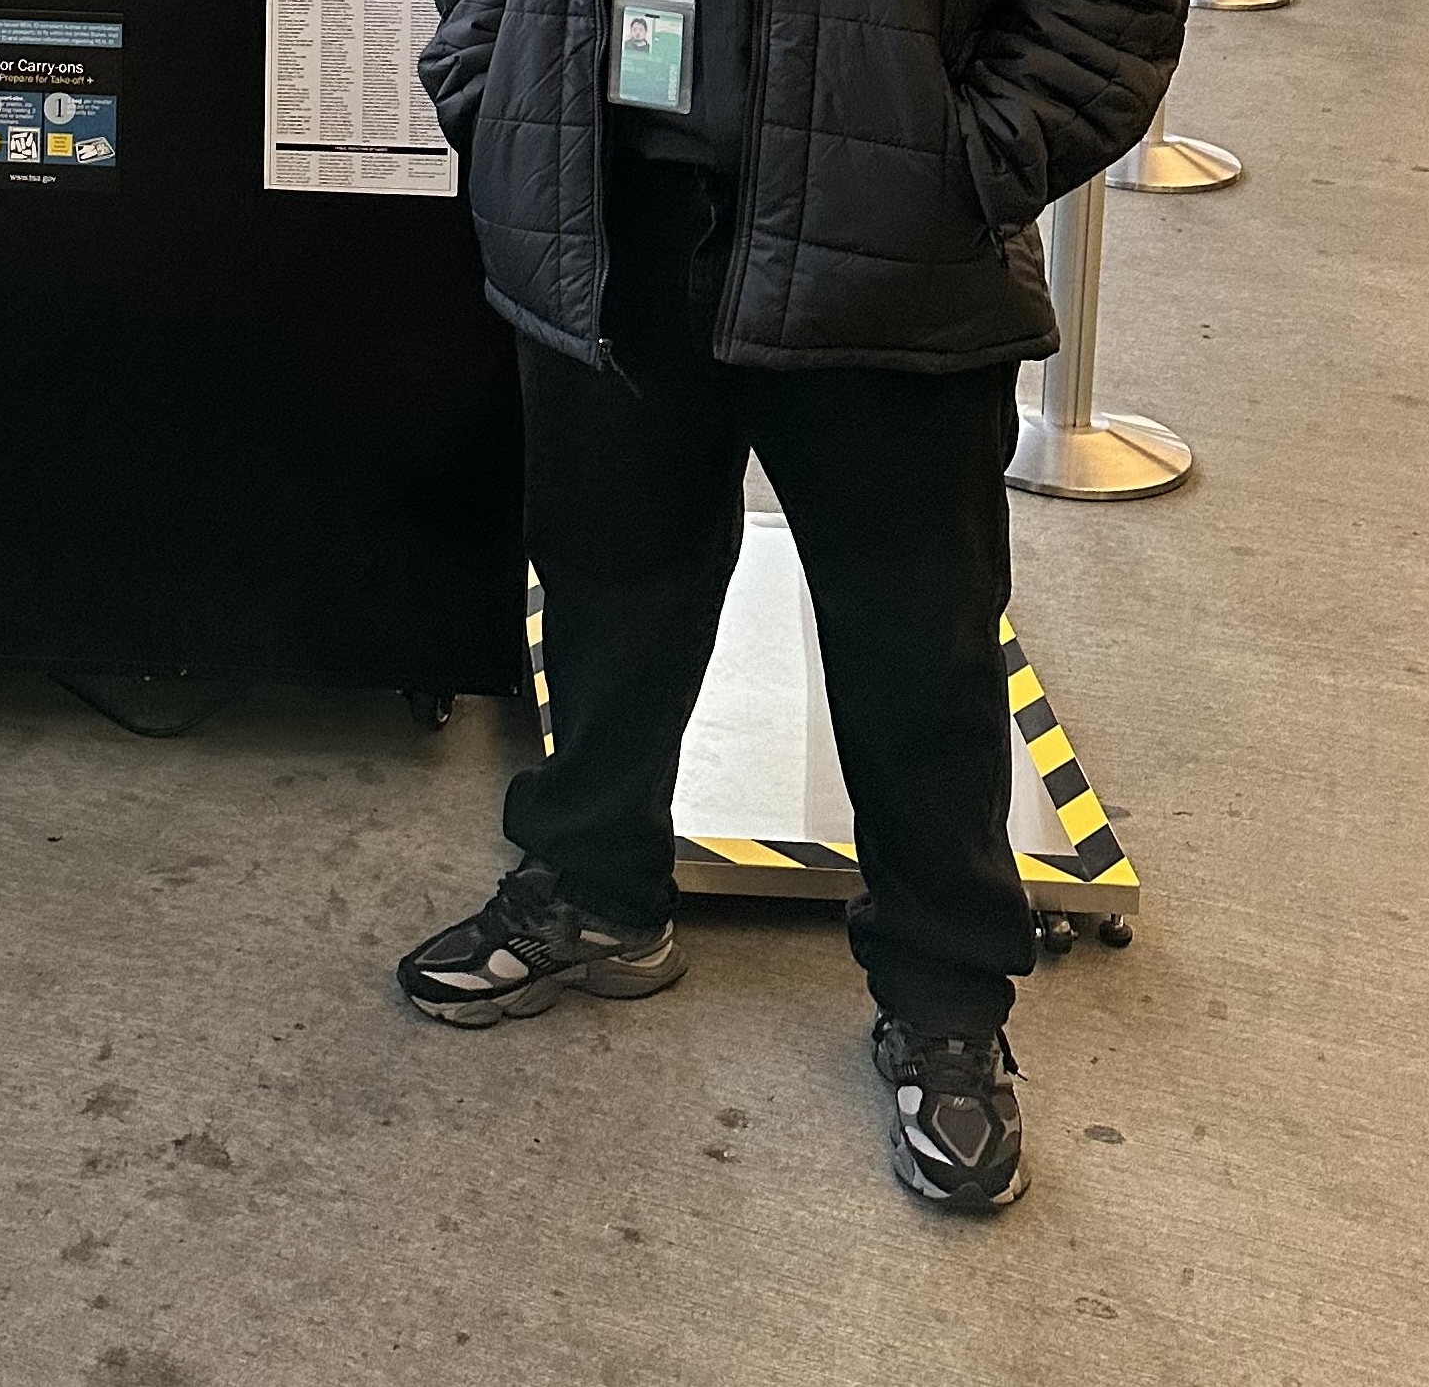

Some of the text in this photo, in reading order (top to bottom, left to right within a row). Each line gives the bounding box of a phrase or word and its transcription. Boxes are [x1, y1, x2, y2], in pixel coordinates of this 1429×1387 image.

[18, 59, 83, 75] Carry-ons
[0, 73, 85, 85] Prepare for Take-off
[56, 98, 63, 117] 1
